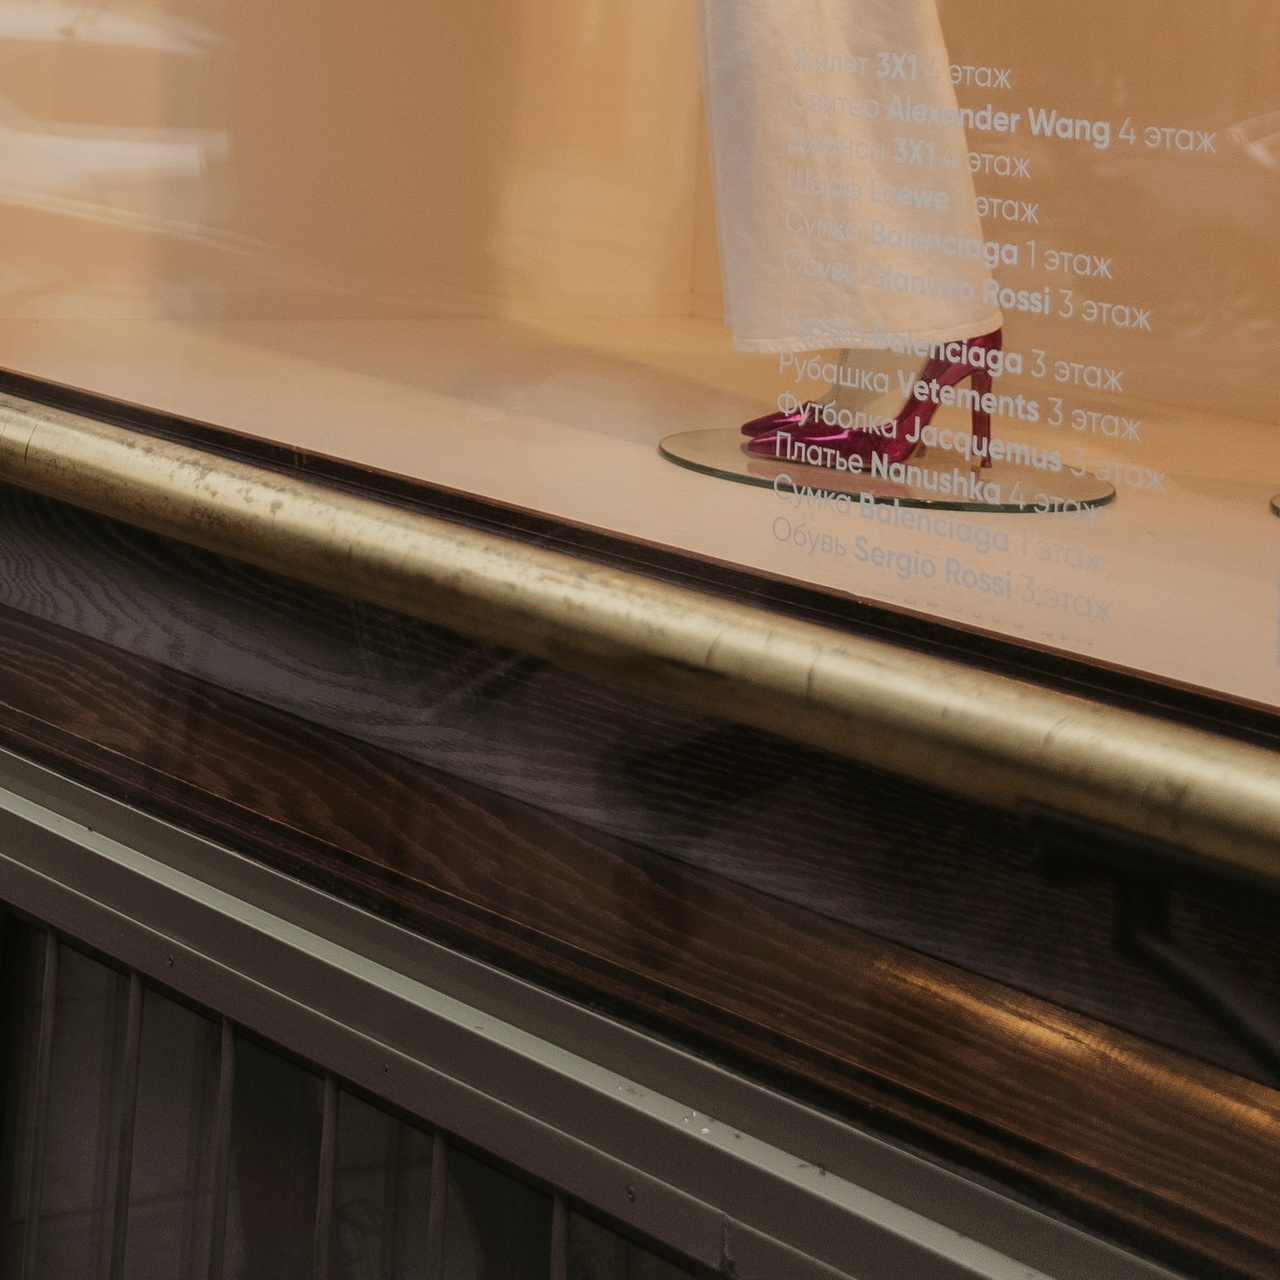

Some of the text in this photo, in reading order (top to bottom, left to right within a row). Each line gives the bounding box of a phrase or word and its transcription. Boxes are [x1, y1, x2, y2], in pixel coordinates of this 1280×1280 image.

[948, 64, 1012, 89] этаж
[886, 94, 1021, 133] Alexander
[1027, 107, 1110, 149] Wang
[1117, 116, 1136, 145] 4
[1143, 126, 1217, 154] этаж
[968, 152, 1031, 179] этаж
[869, 178, 951, 212] Loewe
[975, 196, 1040, 224] этаж
[871, 220, 1019, 269] Balenciaga
[1026, 240, 1037, 268] 1
[1043, 250, 1113, 280] этаж
[982, 278, 1050, 315] Rossi
[1057, 289, 1075, 318] 3
[1081, 300, 1153, 331] этаж
[872, 324, 1023, 377] Balenciaga
[1029, 348, 1047, 378] 3
[1053, 361, 1124, 393] этаж
[777, 349, 1141, 441] Рубашка Vetements 3 этаж
[775, 391, 1167, 493] Футболка Jacquemus 3 этаж
[774, 431, 1103, 524] Платье Nanushka 4 этаж
[773, 473, 851, 515] Сумка
[859, 492, 1010, 554] Balenciaga
[1036, 541, 1106, 573] этаж
[772, 516, 1113, 621] Обувь Sergio Rossi 3 этаж
